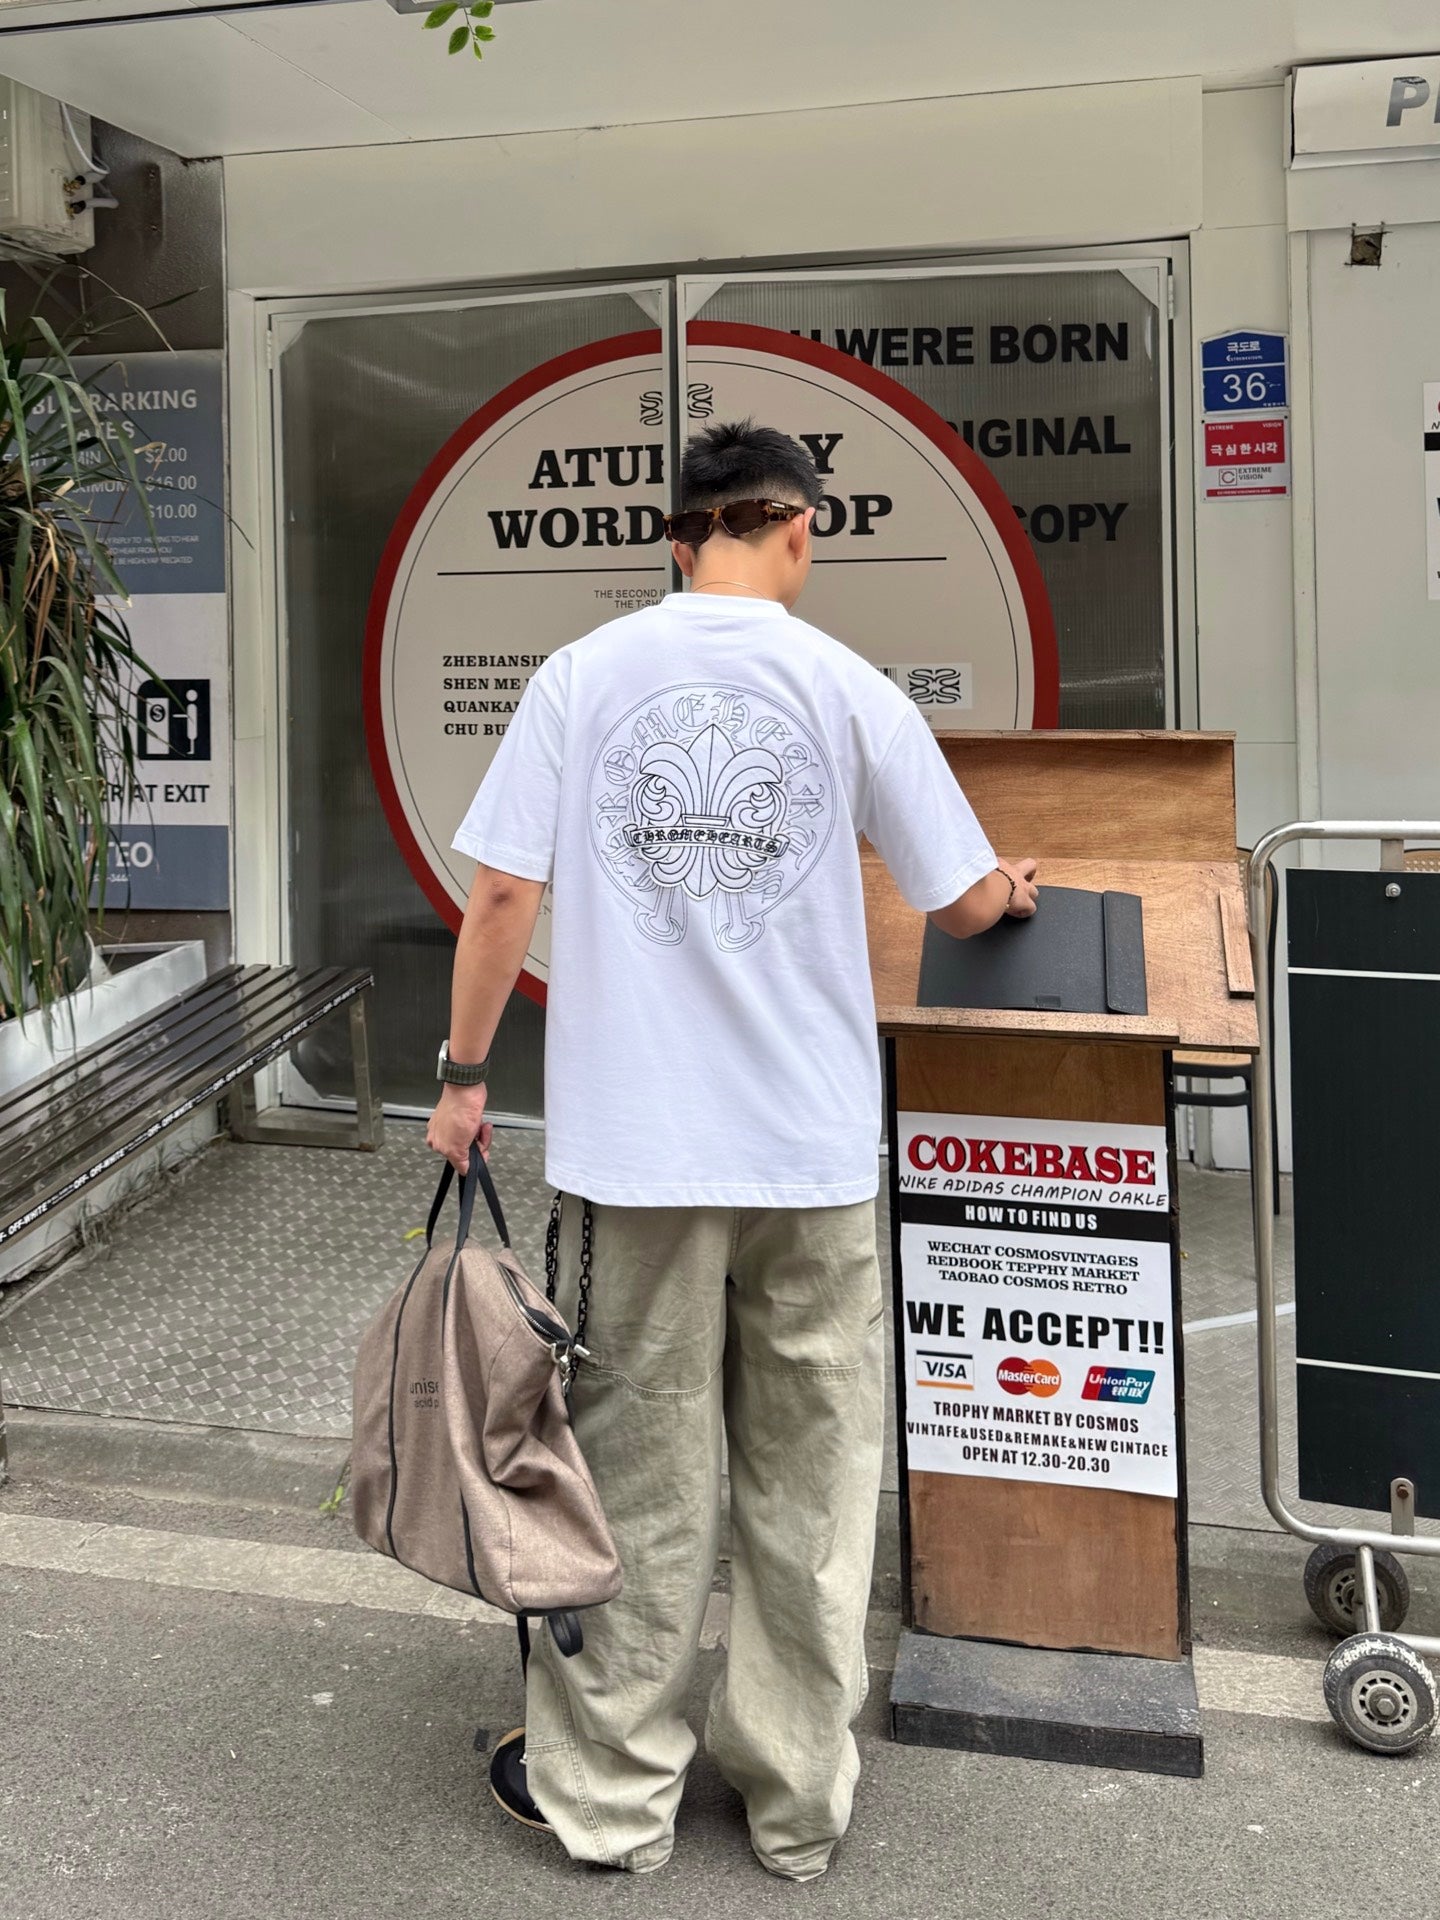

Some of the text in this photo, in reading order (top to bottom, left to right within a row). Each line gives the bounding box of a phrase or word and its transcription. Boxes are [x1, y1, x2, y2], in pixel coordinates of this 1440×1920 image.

[1386, 76, 1440, 127] P
[835, 323, 1128, 366] WERE BORN
[1223, 372, 1266, 403] 36
[947, 415, 1131, 459] IGINAL
[1239, 466, 1272, 474] EXTREME
[594, 589, 614, 599] THE
[615, 589, 658, 599] SECOND
[614, 600, 634, 609] THE
[443, 678, 489, 690] SHEN
[494, 678, 520, 690] ME
[444, 723, 479, 735] CHU
[164, 784, 210, 802] EXIT
[907, 1133, 1156, 1186] COKEBASE
[899, 1174, 1167, 1207] NIKE ADIDAS CHAMPION OAKLE
[965, 1205, 1098, 1231] HOW TO FIND US
[927, 1240, 1139, 1268] WECHAT COSMOSVINTAGES
[927, 1255, 1140, 1282] REDBOOK TEPPHY MARKET
[938, 1269, 1128, 1295] TAOBAO COSMOS RETRO
[906, 1301, 1164, 1354] WE ACCEPT!!
[922, 1360, 967, 1379] VISA
[997, 1368, 1060, 1387] MasterCard
[1088, 1373, 1151, 1393] UnionPay
[933, 1401, 1139, 1434] TROPHY MARKET BY COSMOS
[962, 1445, 1110, 1474] OPEN AT 12.30-20.30
[1110, 1440, 1169, 1457] CINTACE
